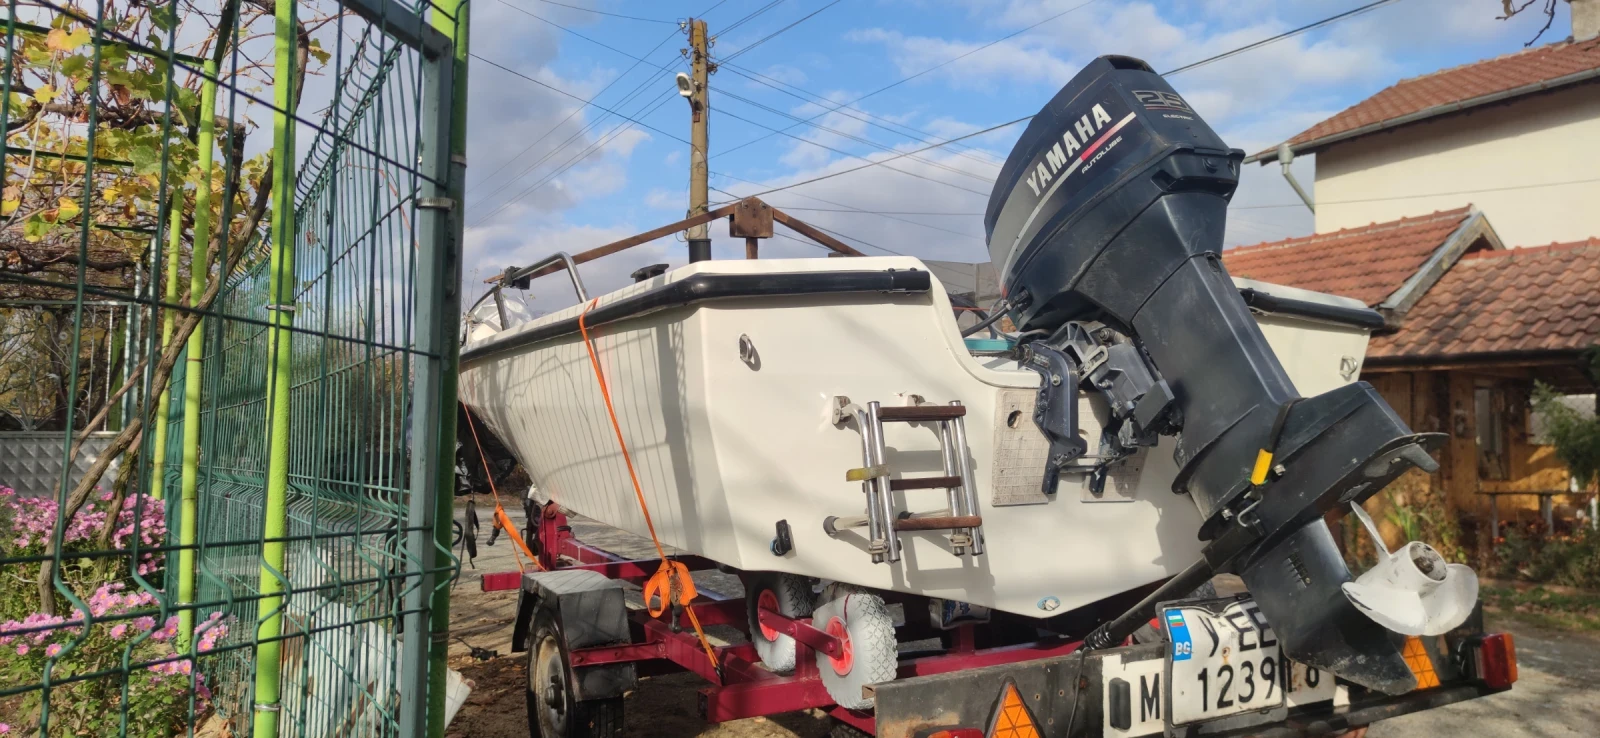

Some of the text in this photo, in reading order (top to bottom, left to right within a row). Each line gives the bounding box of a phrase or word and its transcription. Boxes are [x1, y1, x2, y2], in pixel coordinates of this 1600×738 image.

[1026, 103, 1112, 197] YAMAHA
[1081, 135, 1123, 174] AUTOLUBE
[1175, 642, 1191, 656] BG
[1197, 656, 1276, 712] 1239
